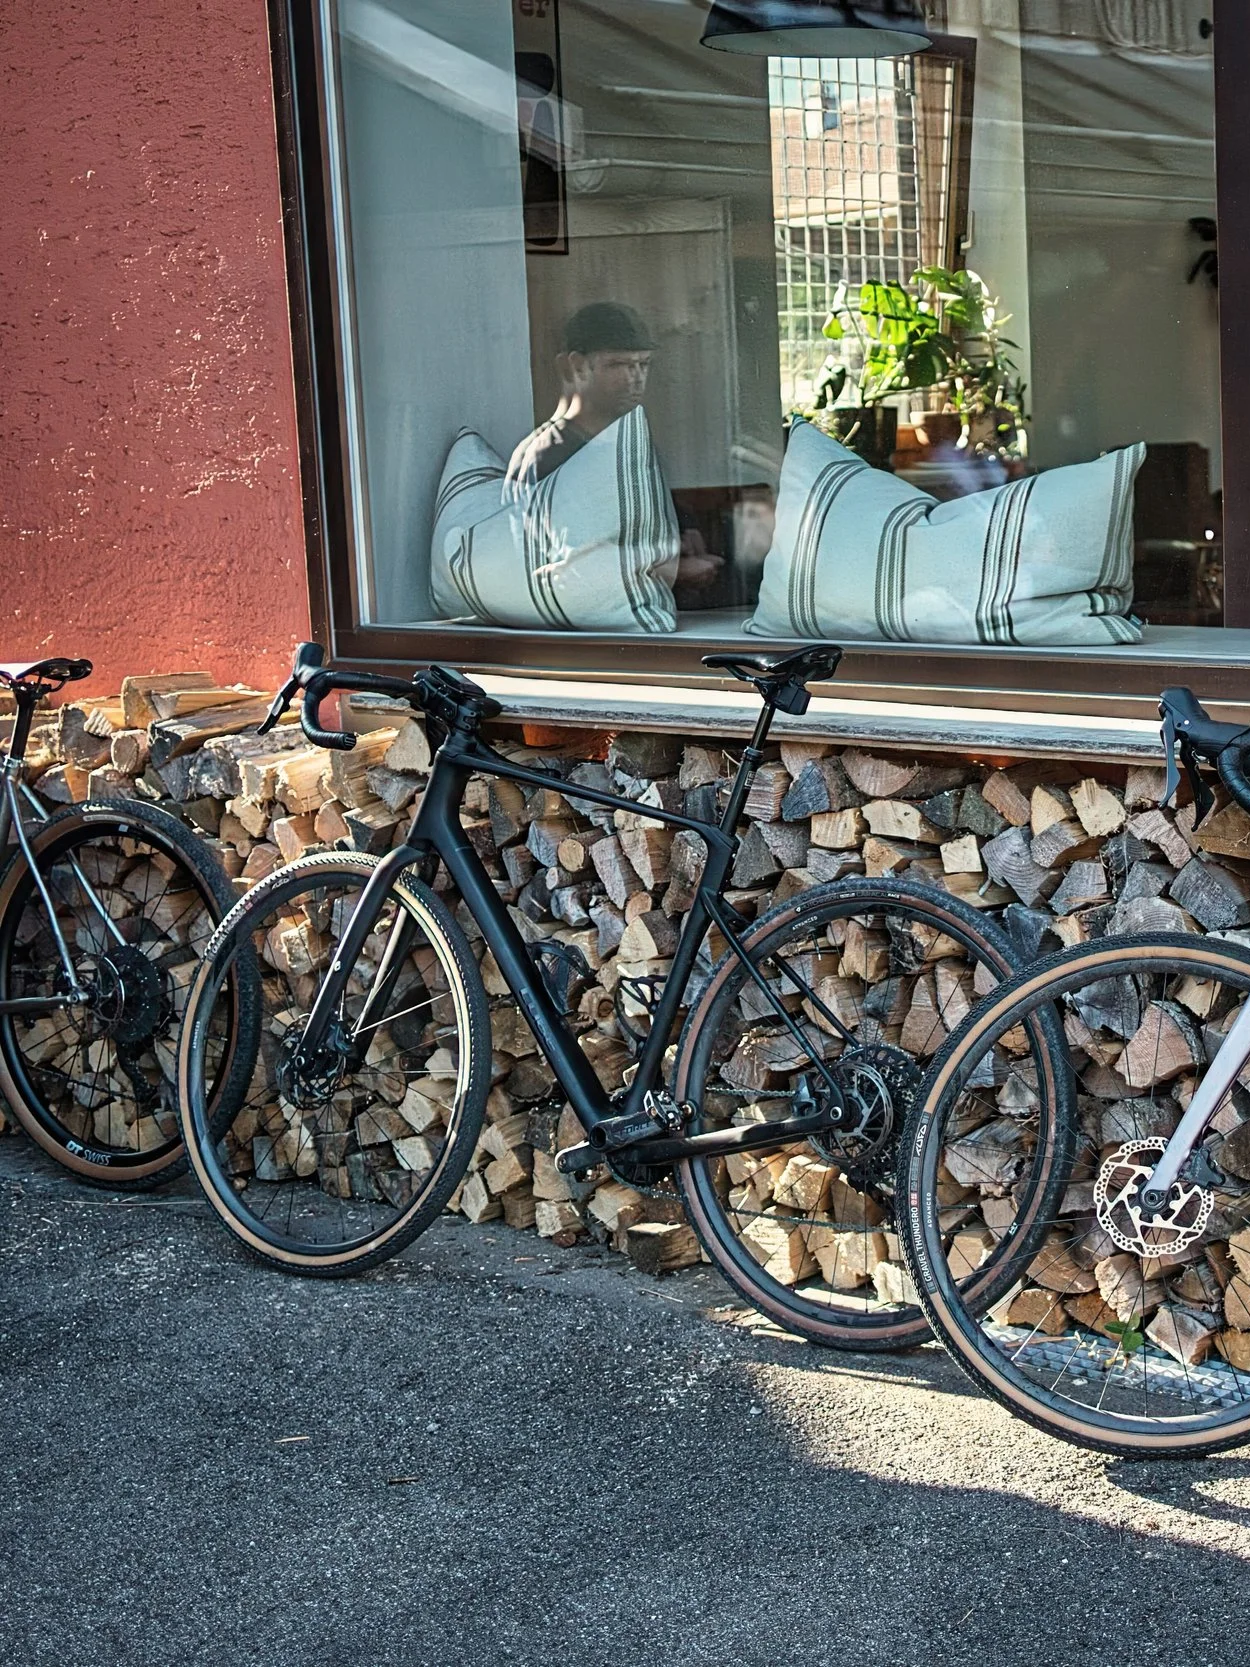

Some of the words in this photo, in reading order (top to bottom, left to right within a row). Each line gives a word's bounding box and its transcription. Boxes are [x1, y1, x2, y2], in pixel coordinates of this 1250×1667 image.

[66, 1140, 83, 1155] DT
[83, 1149, 111, 1166] SWISS
[925, 1192, 933, 1228] ADVANCED
[910, 1206, 923, 1251] THUNDERO
[918, 1251, 932, 1282] GRAVEL
